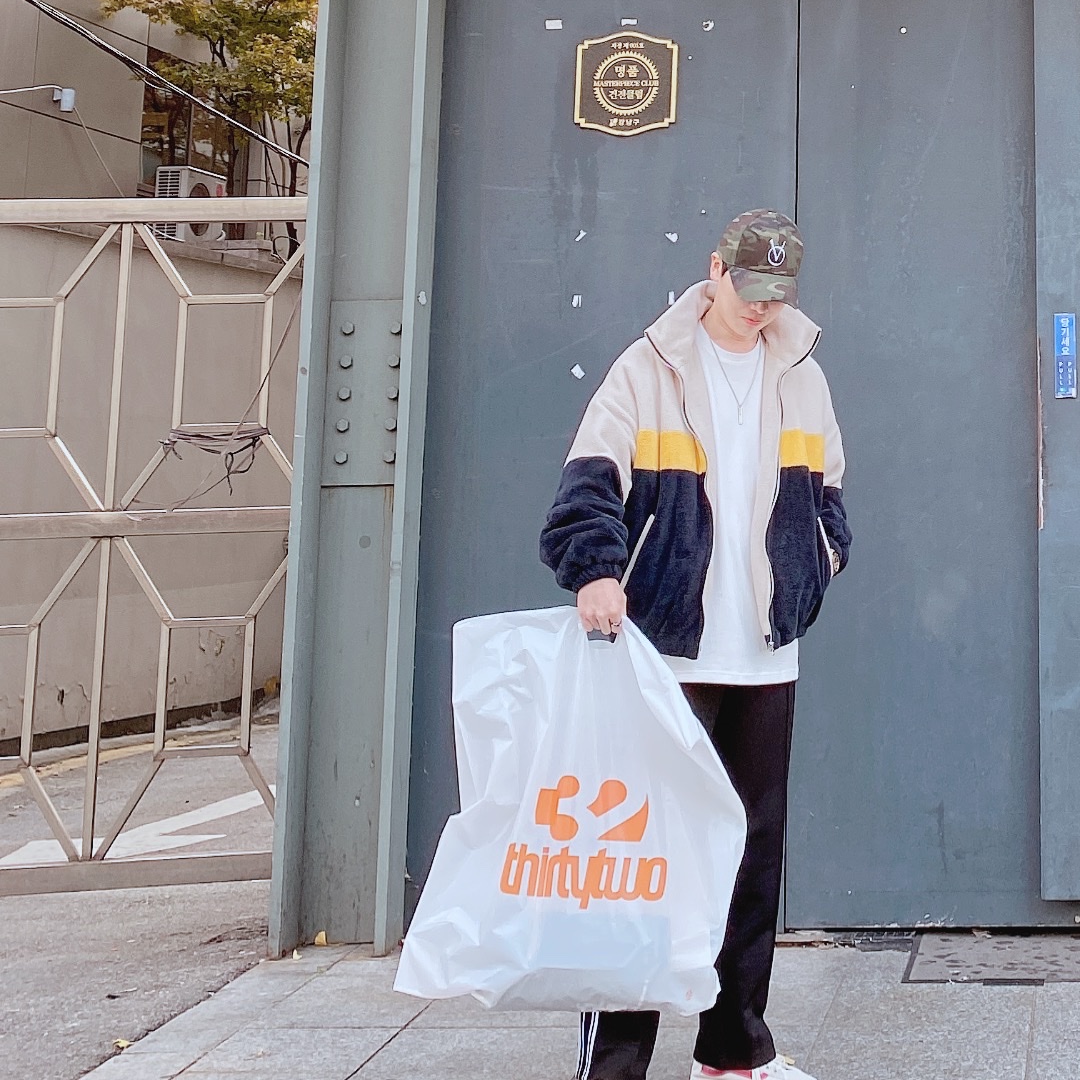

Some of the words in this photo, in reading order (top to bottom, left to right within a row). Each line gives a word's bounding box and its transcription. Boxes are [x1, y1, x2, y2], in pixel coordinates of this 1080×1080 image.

[593, 79, 640, 87] MASTERPIECE
[640, 79, 660, 87] CLUB
[614, 64, 640, 78] 명품
[1060, 317, 1070, 356] 당기세요
[500, 842, 668, 910] thirtytwo
